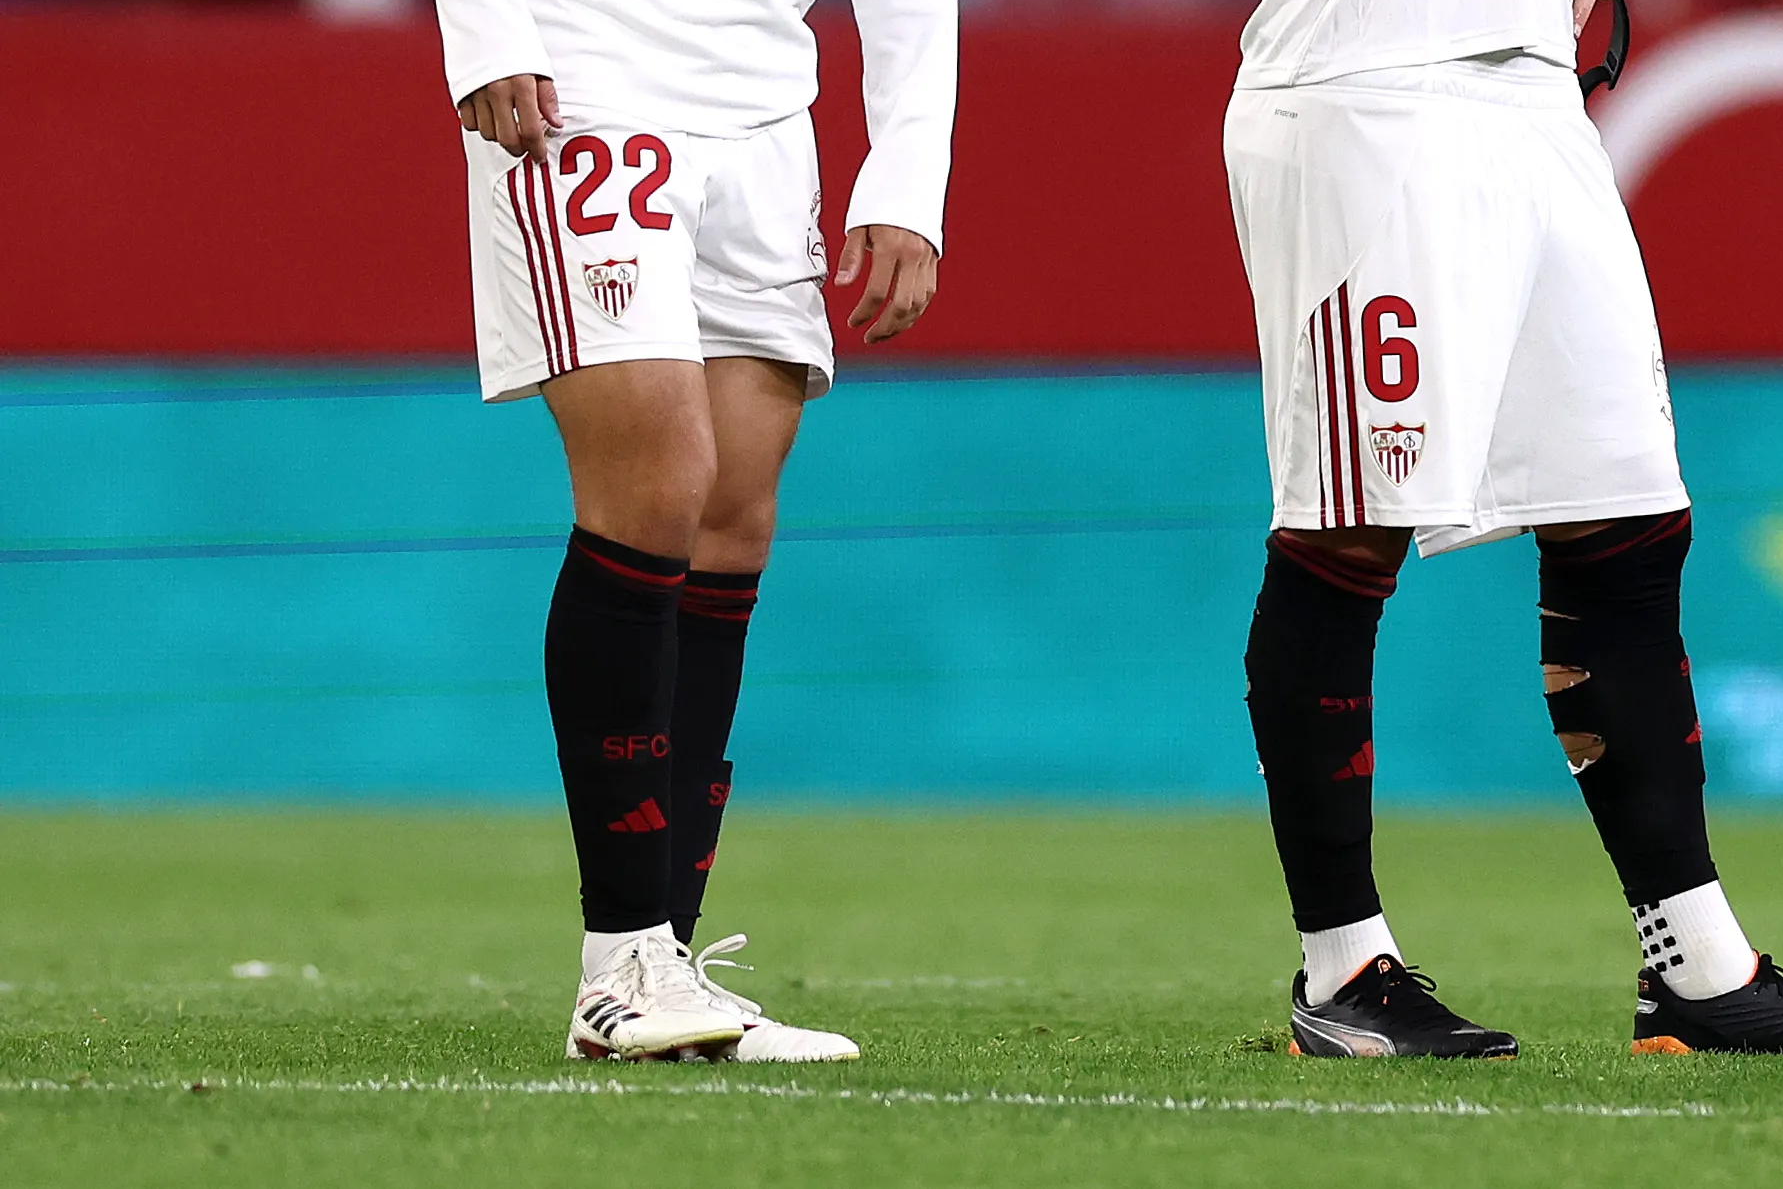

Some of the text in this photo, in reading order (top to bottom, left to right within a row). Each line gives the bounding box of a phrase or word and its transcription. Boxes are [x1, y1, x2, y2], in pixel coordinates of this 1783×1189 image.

[559, 133, 674, 236] 22
[1361, 295, 1420, 403] 6
[603, 734, 669, 760] SFC
